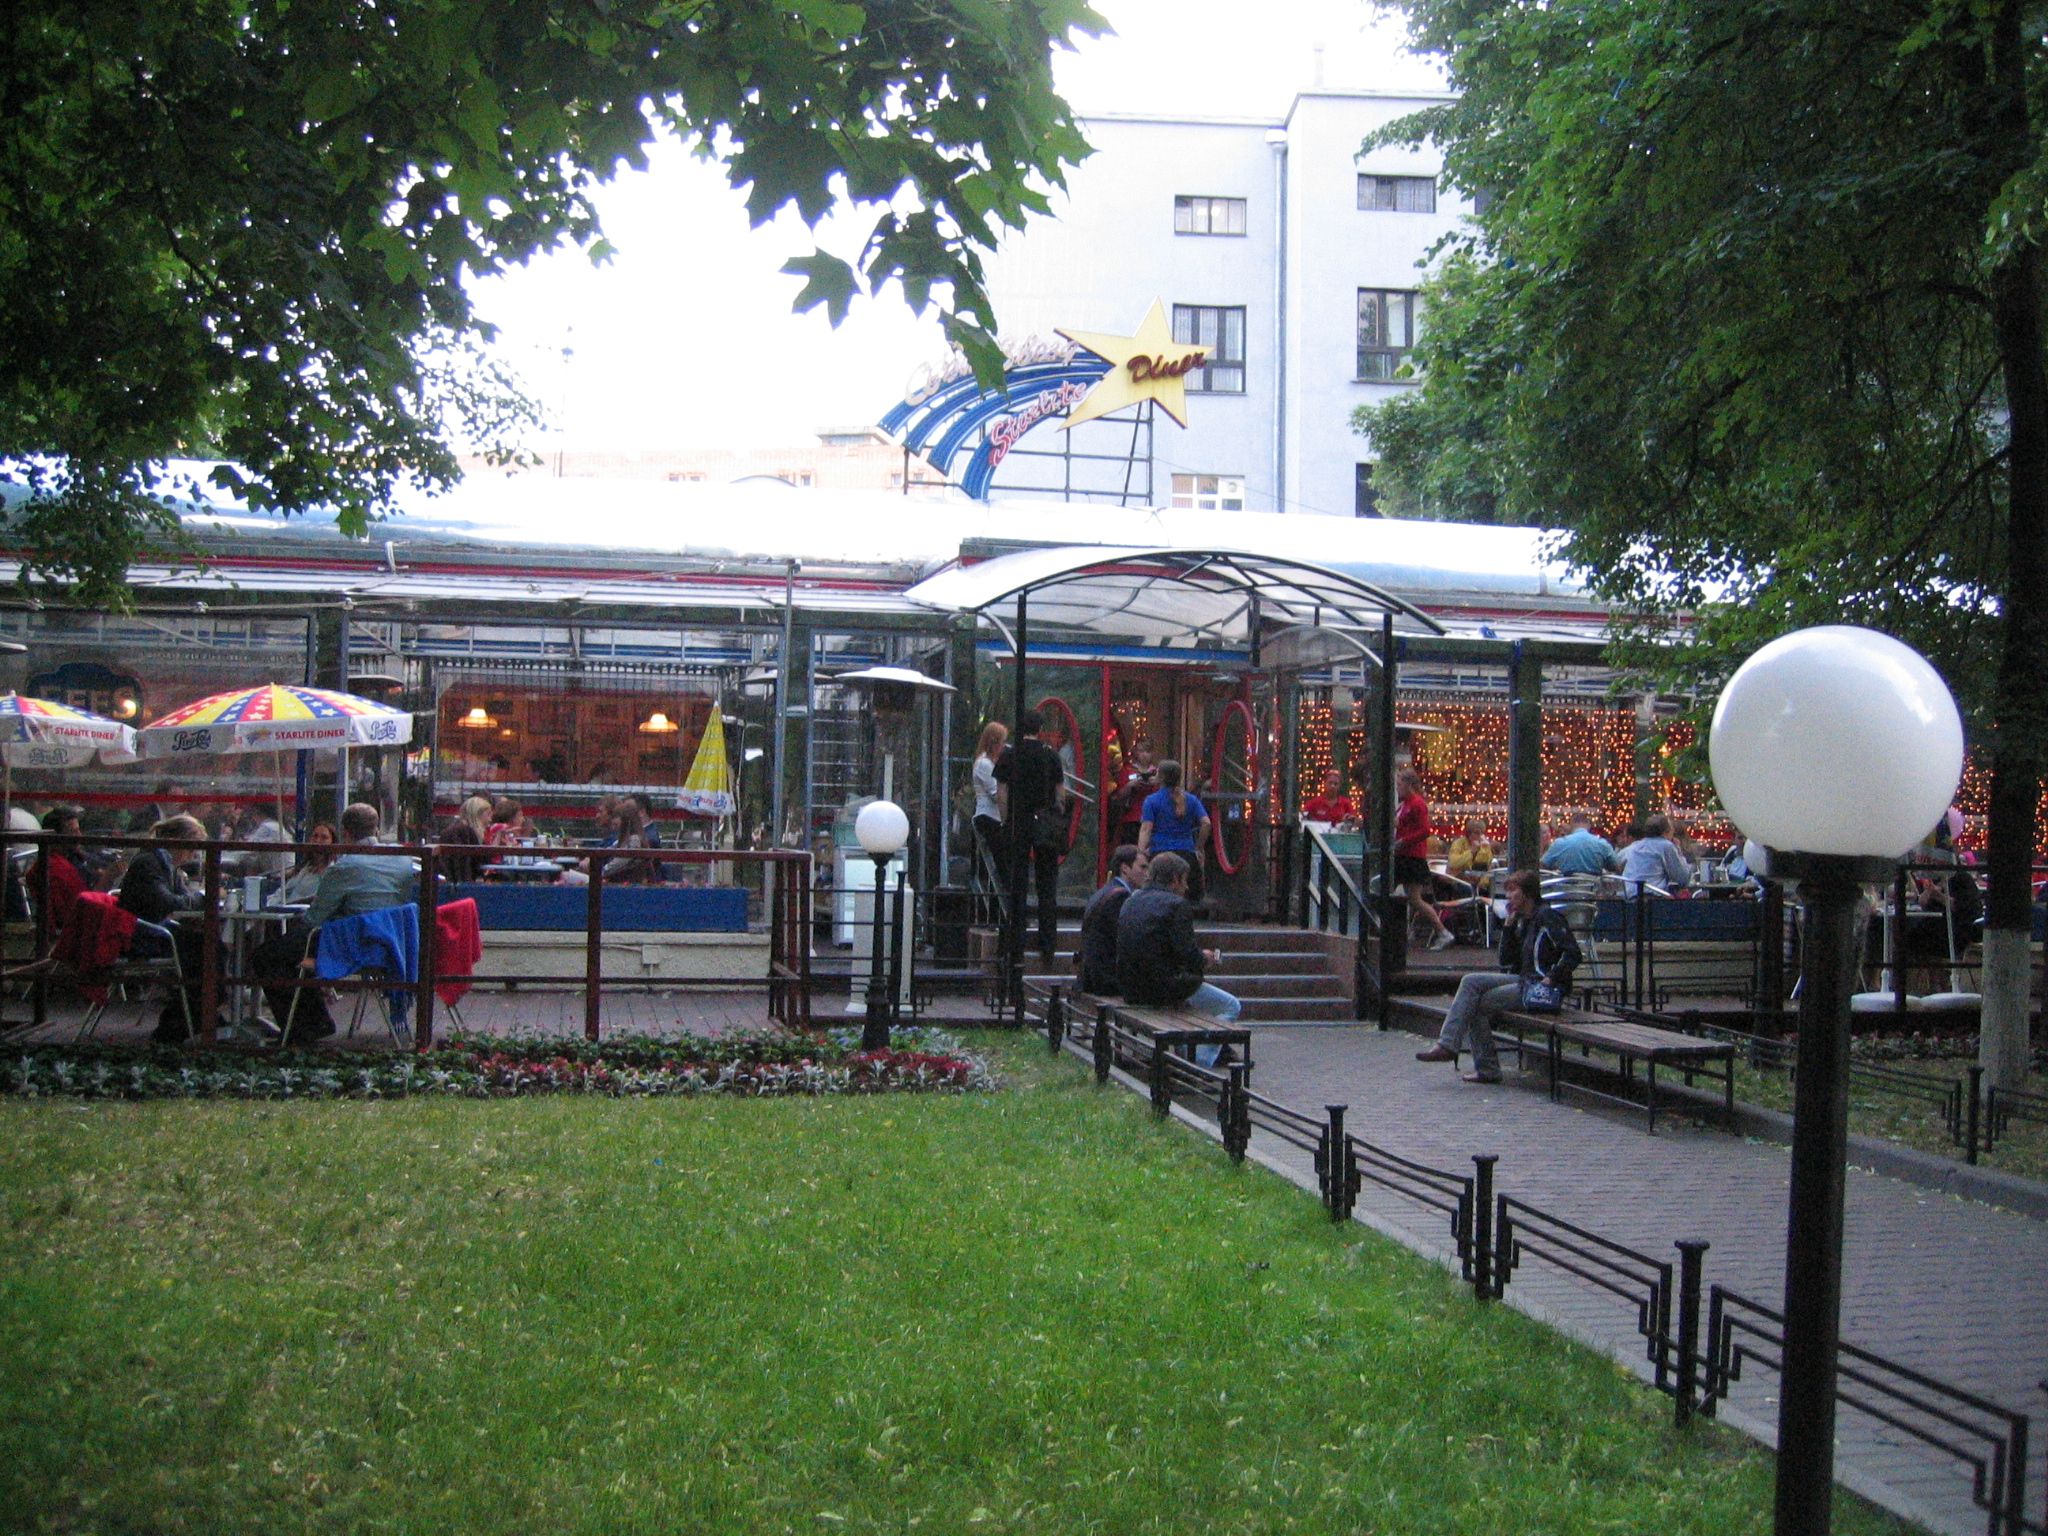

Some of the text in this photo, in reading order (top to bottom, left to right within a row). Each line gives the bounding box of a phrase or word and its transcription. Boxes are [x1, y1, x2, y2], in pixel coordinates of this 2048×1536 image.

[1127, 352, 1206, 383] Diner
[988, 380, 1087, 467] Starlite
[54, 727, 115, 741] STARLITE DINER
[275, 730, 315, 740] STARLITE
[317, 728, 346, 738] DINER
